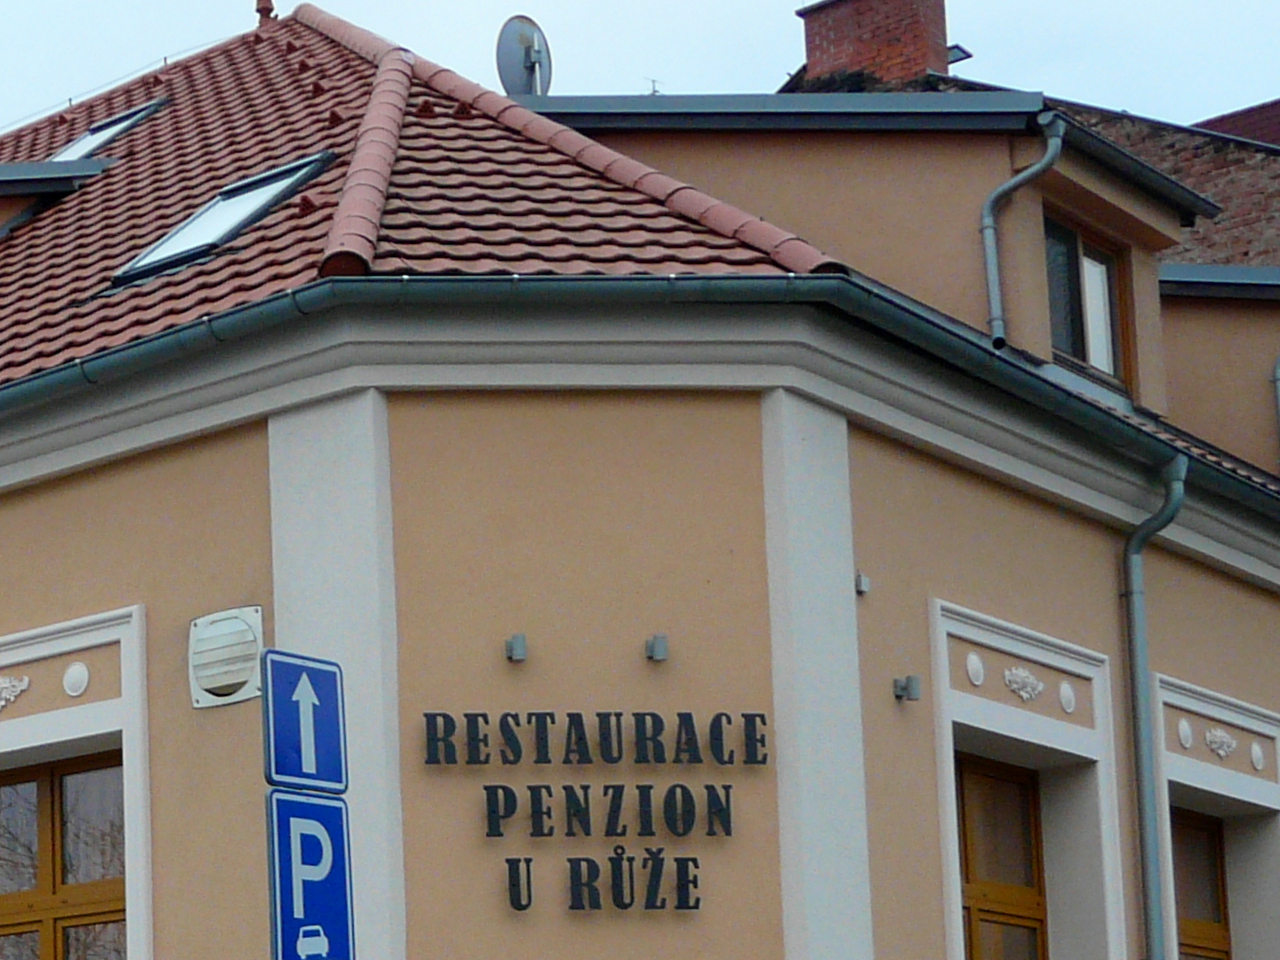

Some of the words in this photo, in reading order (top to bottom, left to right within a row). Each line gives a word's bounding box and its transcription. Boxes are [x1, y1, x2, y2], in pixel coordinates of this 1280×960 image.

[423, 712, 768, 764] RESTAURACE
[483, 784, 733, 837] PENZION
[289, 817, 333, 919] P
[505, 858, 533, 912] U
[567, 845, 701, 911] RŮŽE
